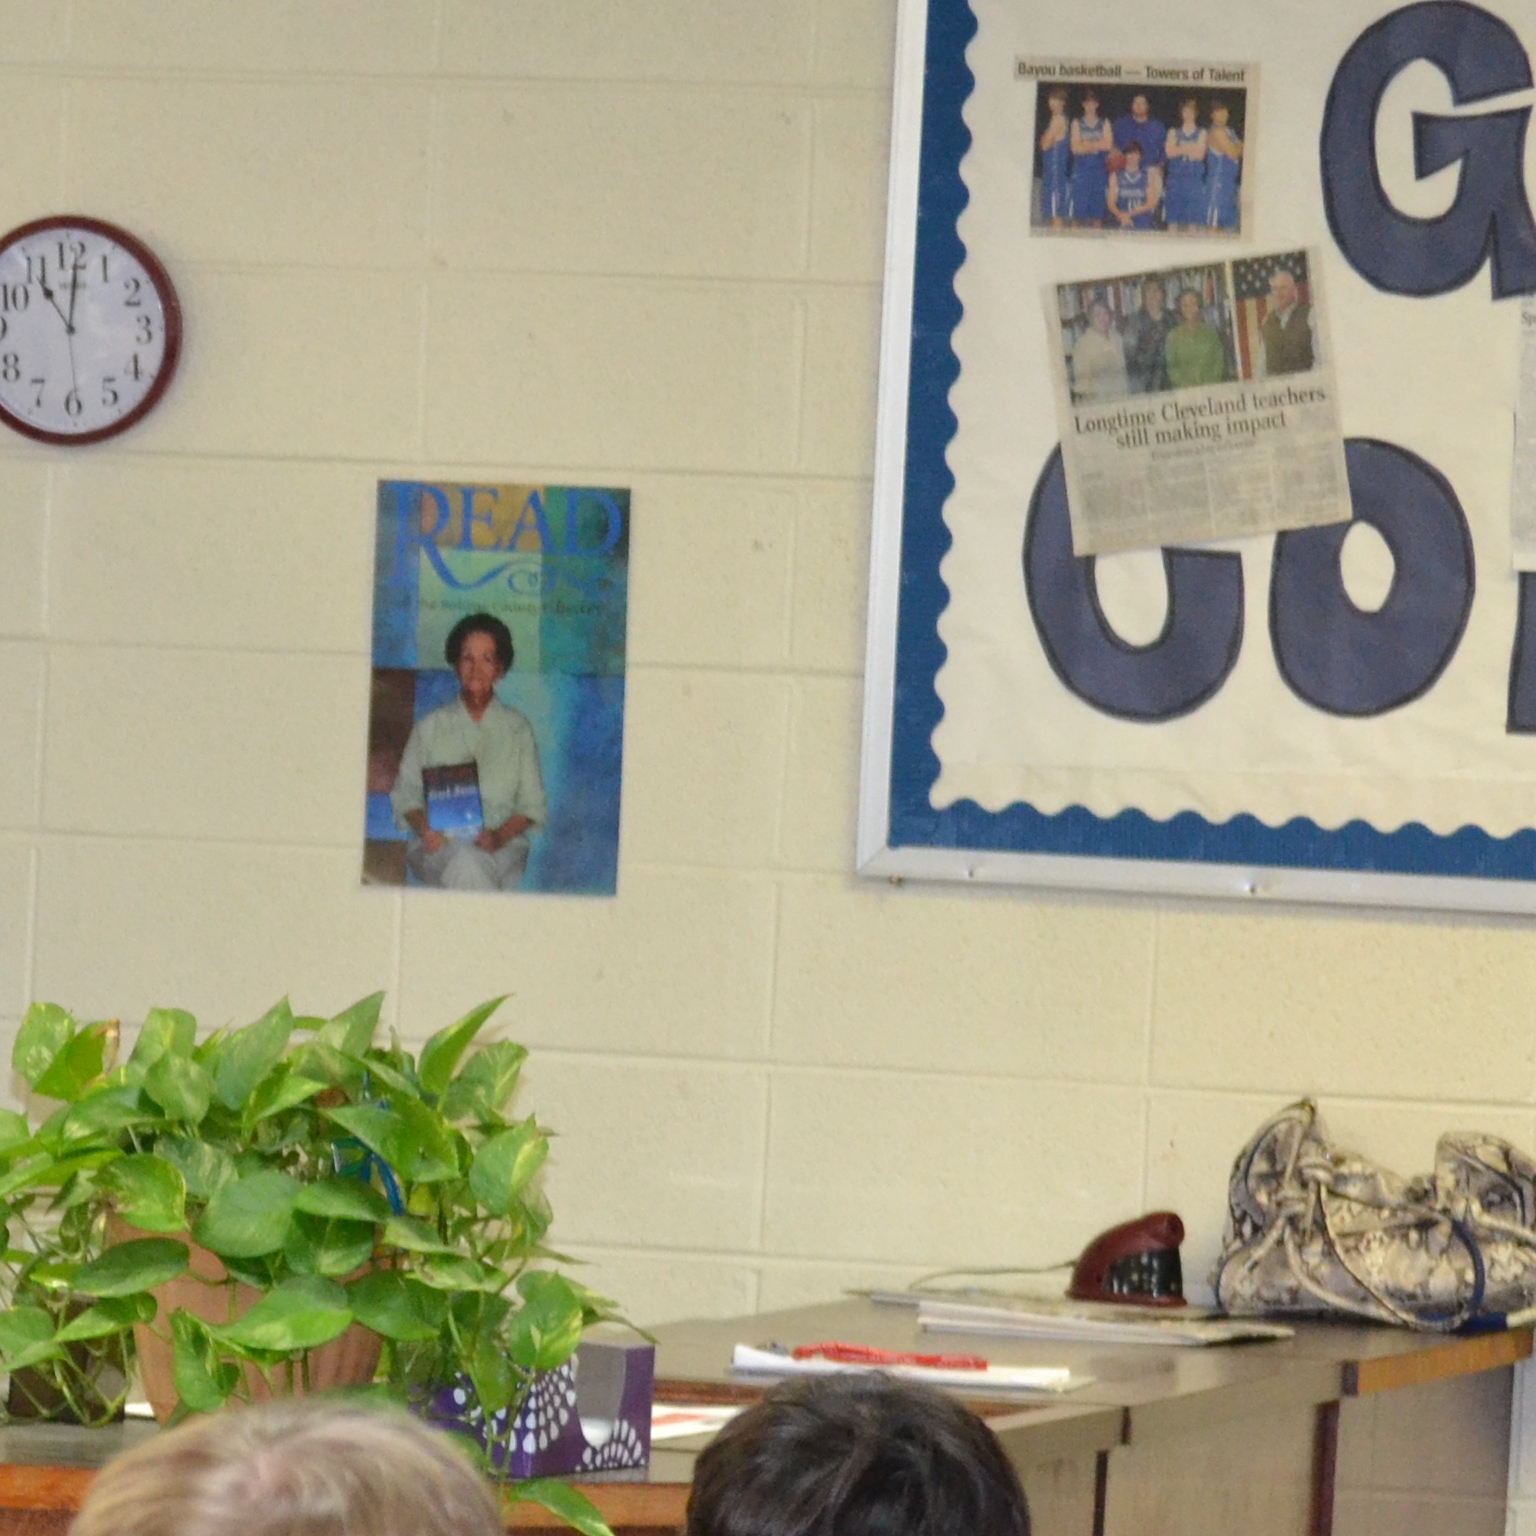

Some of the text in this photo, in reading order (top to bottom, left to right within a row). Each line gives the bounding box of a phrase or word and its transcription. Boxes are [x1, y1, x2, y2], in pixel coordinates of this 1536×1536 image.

[1018, 62, 1056, 77] Bayou
[1059, 63, 1122, 78] basketball
[1146, 66, 1189, 80] Towers
[1192, 67, 1205, 80] of
[1208, 68, 1246, 82] Talent
[26, 255, 46, 285] 11
[56, 241, 87, 271] 12
[100, 255, 109, 283] 1
[1, 284, 29, 312] 10
[124, 278, 141, 307] 2
[136, 316, 153, 345] 3
[2, 353, 20, 383] 8
[124, 353, 143, 382] 4
[31, 378, 46, 408] 7
[64, 388, 83, 417] 6
[101, 377, 118, 406] 5
[1074, 385, 1326, 438] Longtime Cleveland teachers
[1116, 428, 1150, 450] still
[1155, 417, 1221, 445] making
[1226, 411, 1287, 438] impact
[384, 480, 623, 590] READ
